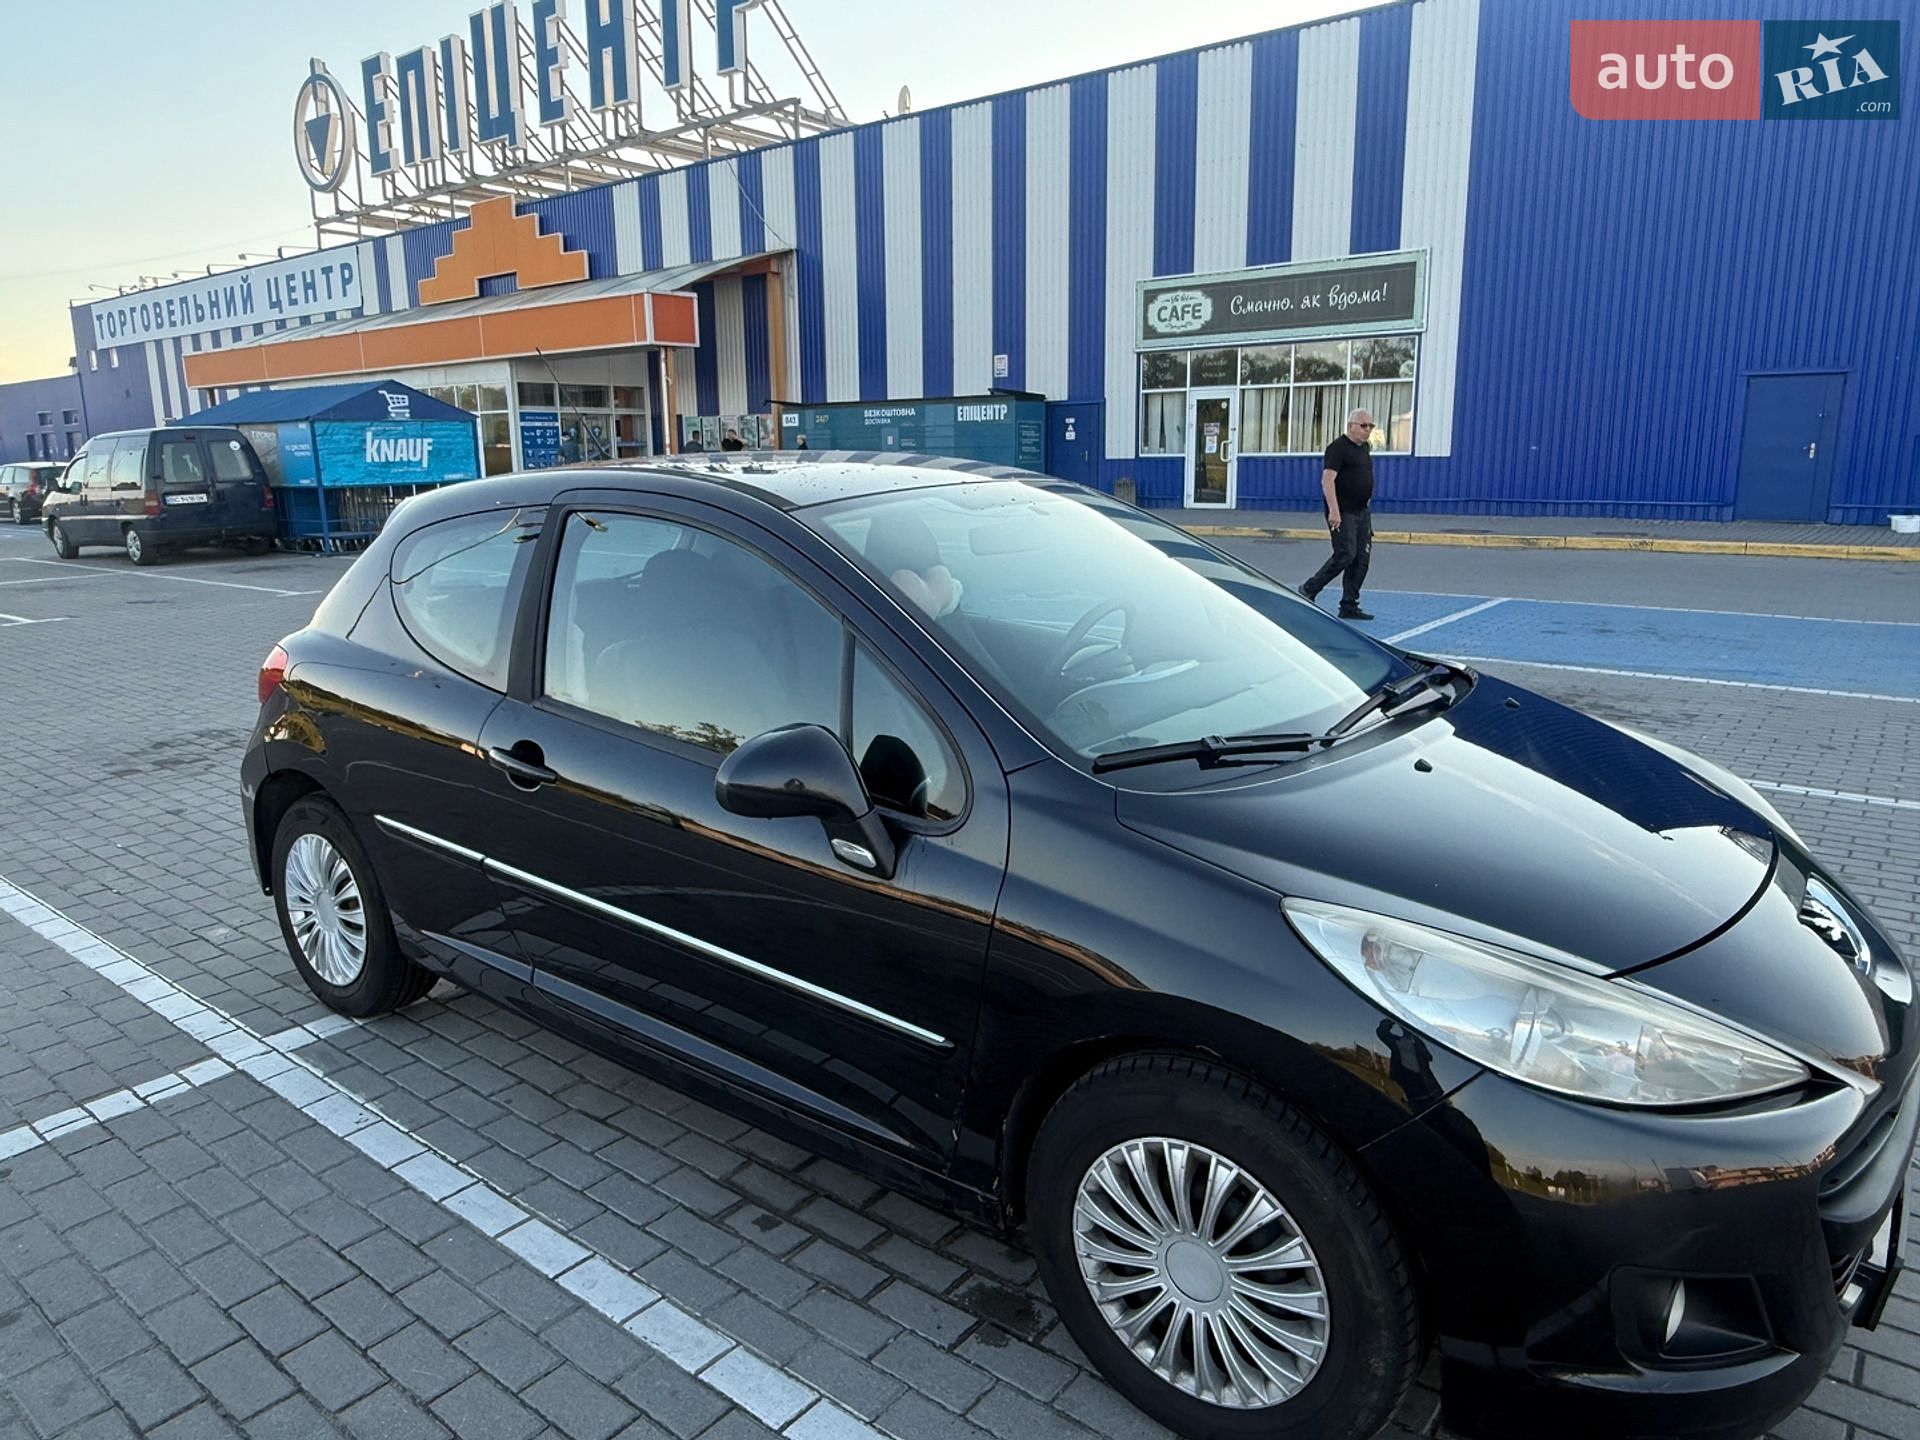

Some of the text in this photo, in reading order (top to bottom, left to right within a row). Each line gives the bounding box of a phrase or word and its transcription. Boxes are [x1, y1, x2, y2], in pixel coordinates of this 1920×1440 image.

[96, 262, 354, 341] ТОРГОВЕЛЬНИЙ ЦЕНТР
[1300, 294, 1321, 310] як
[1327, 282, 1388, 310] вдома!
[1157, 303, 1202, 323] CAFE
[864, 408, 915, 418] БЕЗКОШТОВНА
[957, 404, 1008, 422] ЕПІЦЕНТР
